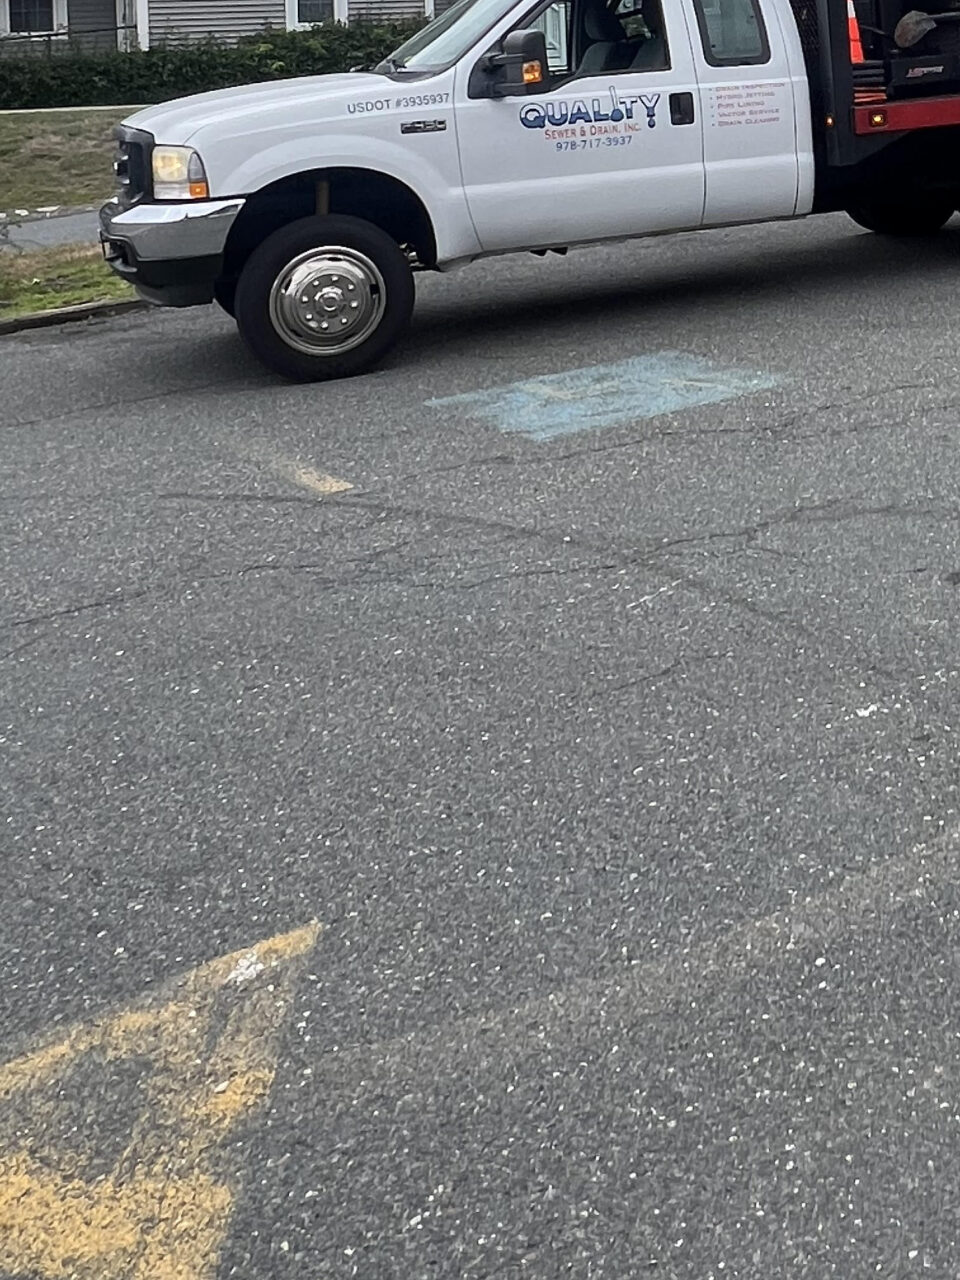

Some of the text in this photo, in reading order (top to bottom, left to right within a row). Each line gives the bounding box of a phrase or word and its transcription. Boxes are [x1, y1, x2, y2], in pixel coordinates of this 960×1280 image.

[347, 92, 450, 114] USDOT #3935937
[519, 86, 660, 129] QUALITY
[544, 128, 576, 140] SEWER
[580, 125, 586, 137] &
[556, 135, 632, 152] 978-717-3937
